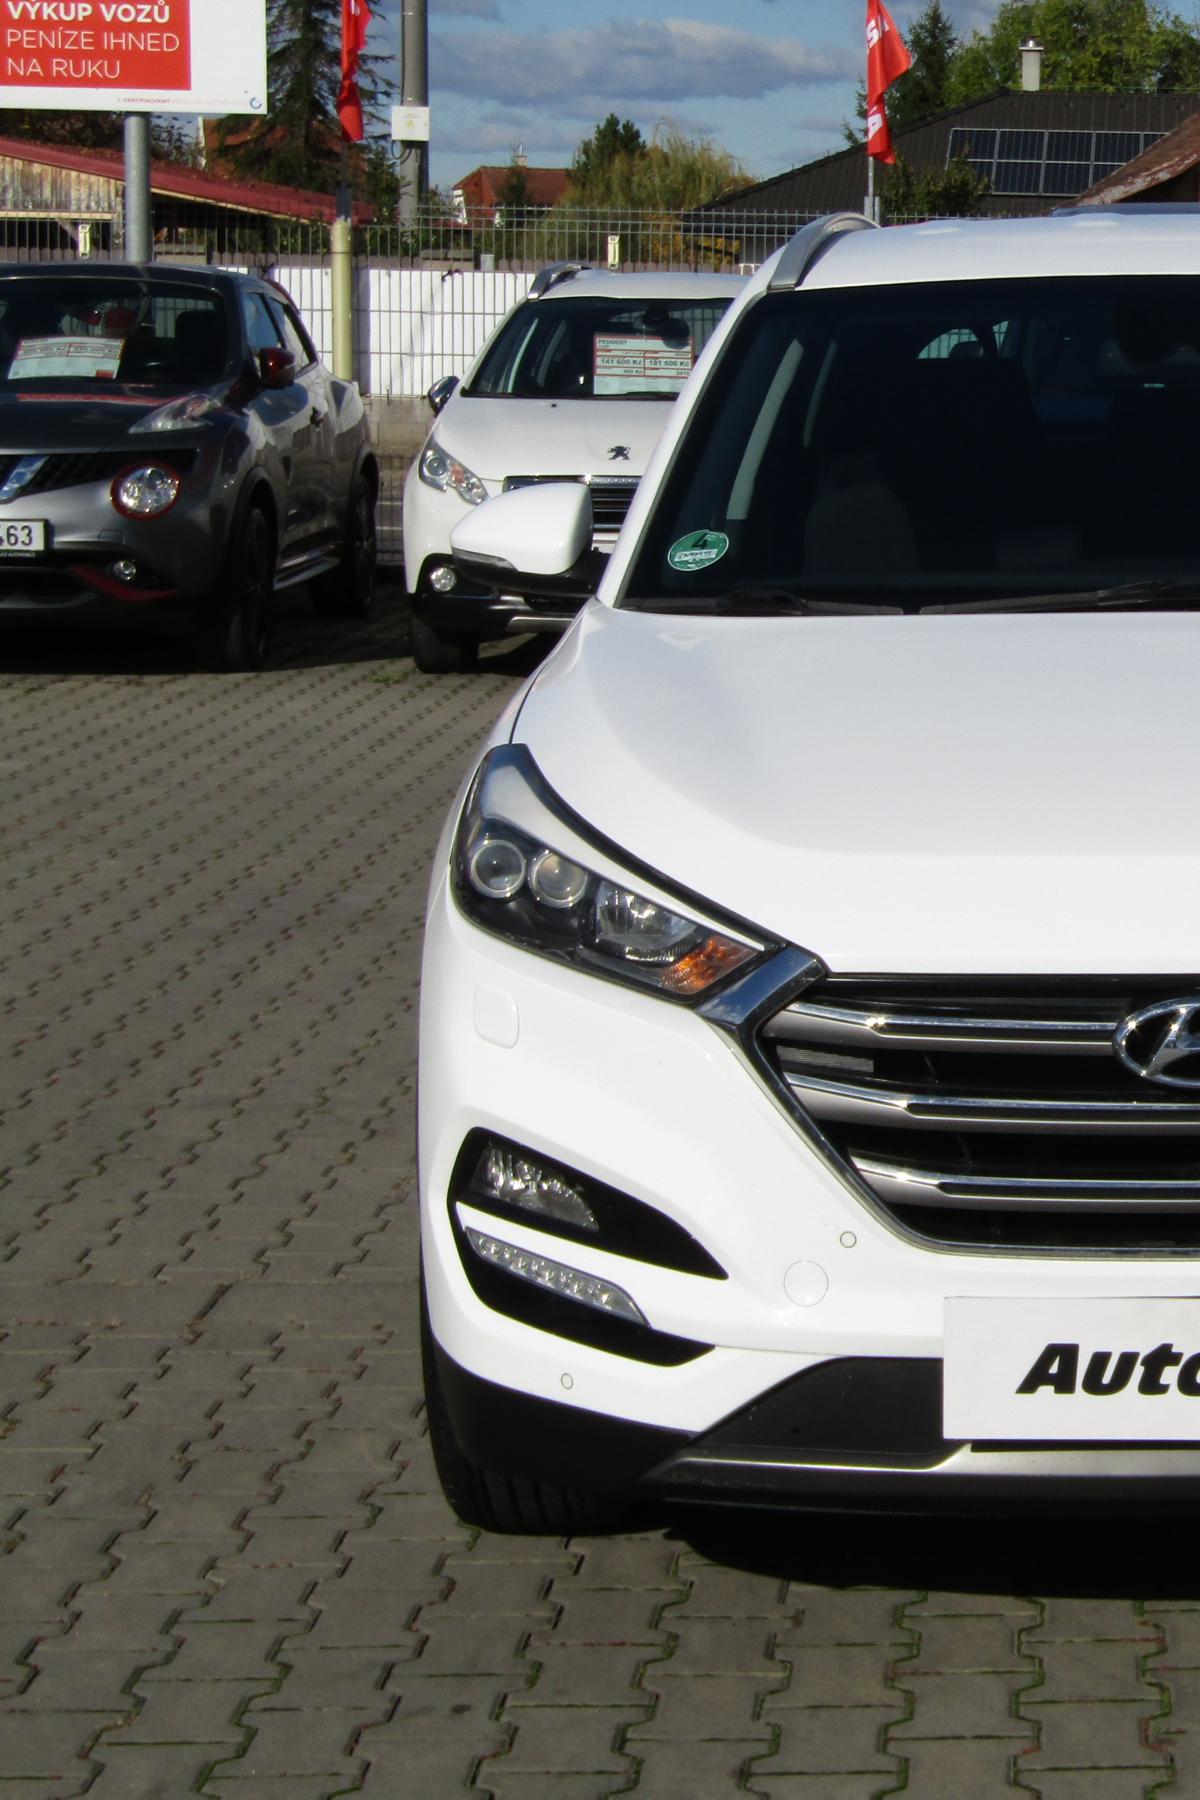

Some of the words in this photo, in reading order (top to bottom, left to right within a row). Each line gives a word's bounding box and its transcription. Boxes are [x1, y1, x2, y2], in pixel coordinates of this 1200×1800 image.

[7, 0, 93, 21] VÝKUP
[101, 0, 170, 23] VOZŮ
[7, 27, 95, 50] PENÍZE
[104, 32, 180, 52] IHNED
[7, 58, 43, 77] NA
[53, 59, 120, 79] RUKU
[0, 524, 33, 547] 63
[692, 533, 708, 549] 4
